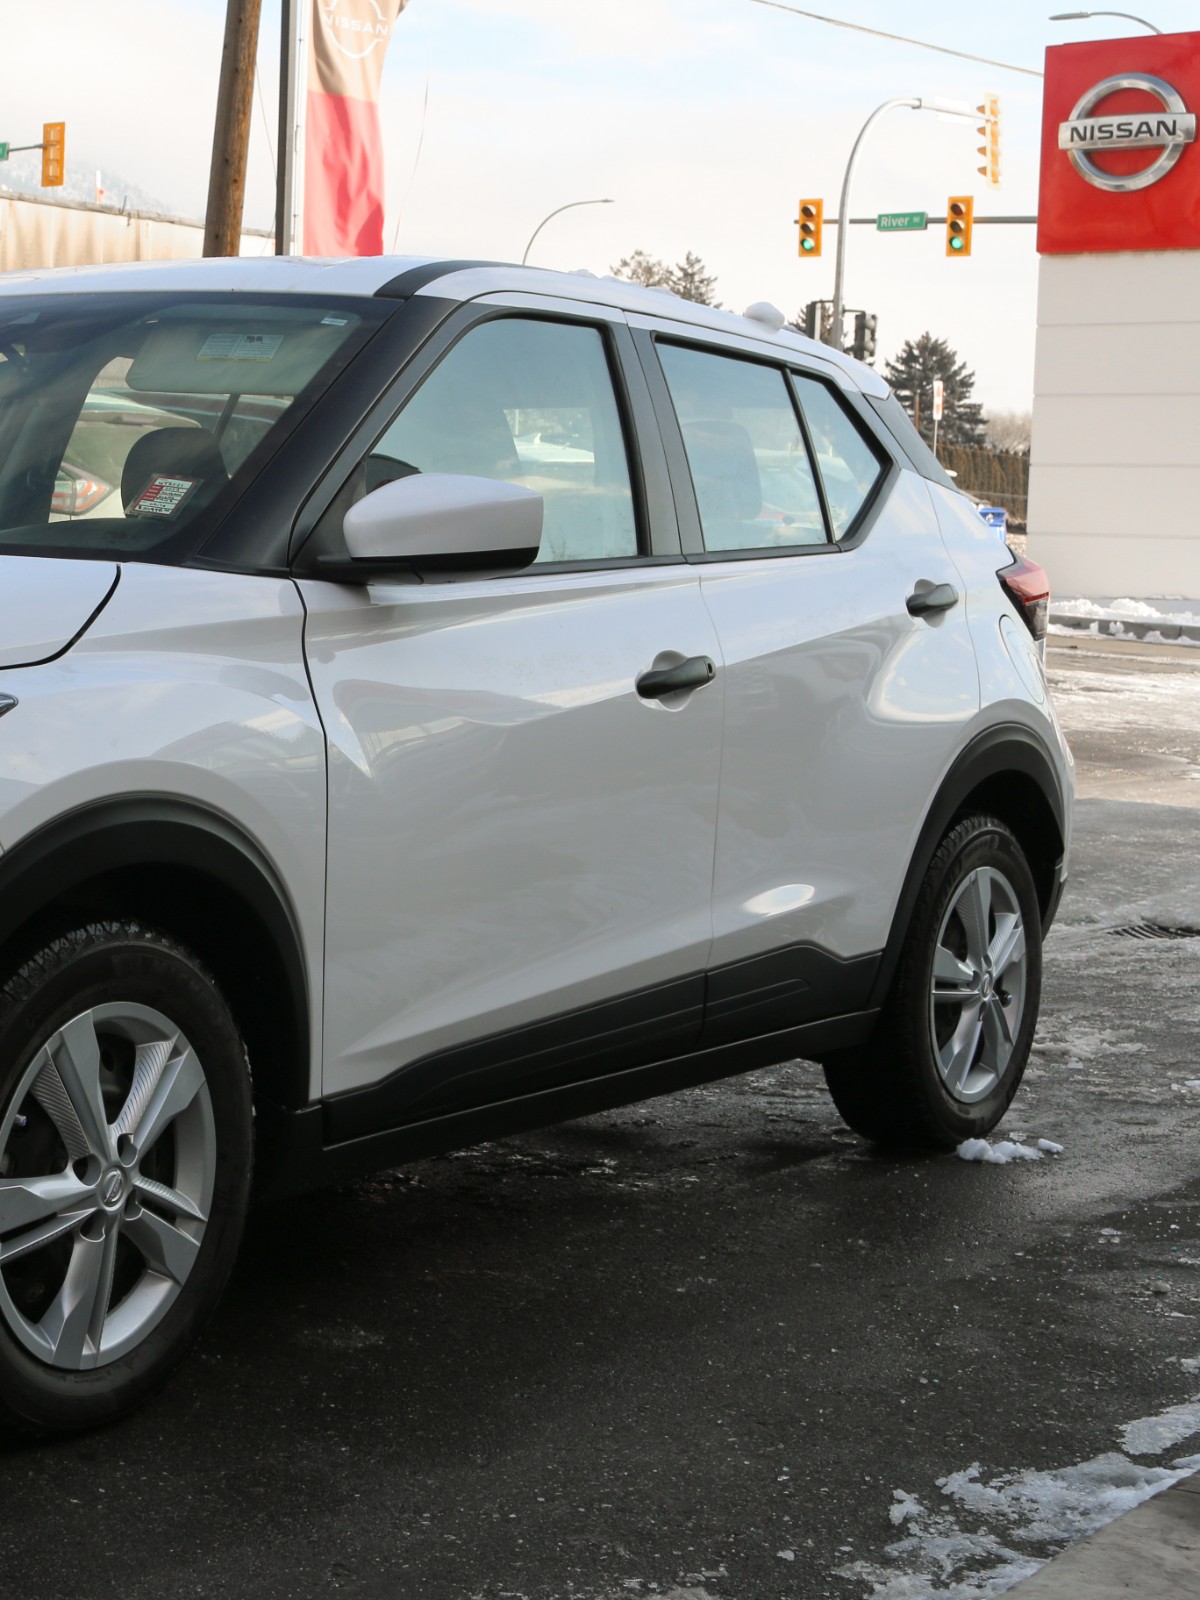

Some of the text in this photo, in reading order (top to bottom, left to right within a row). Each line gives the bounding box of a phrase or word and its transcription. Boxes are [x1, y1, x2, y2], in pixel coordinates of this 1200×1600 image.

[322, 14, 388, 36] NISSAN
[1070, 119, 1177, 143] NISSAN
[880, 215, 909, 228] River
